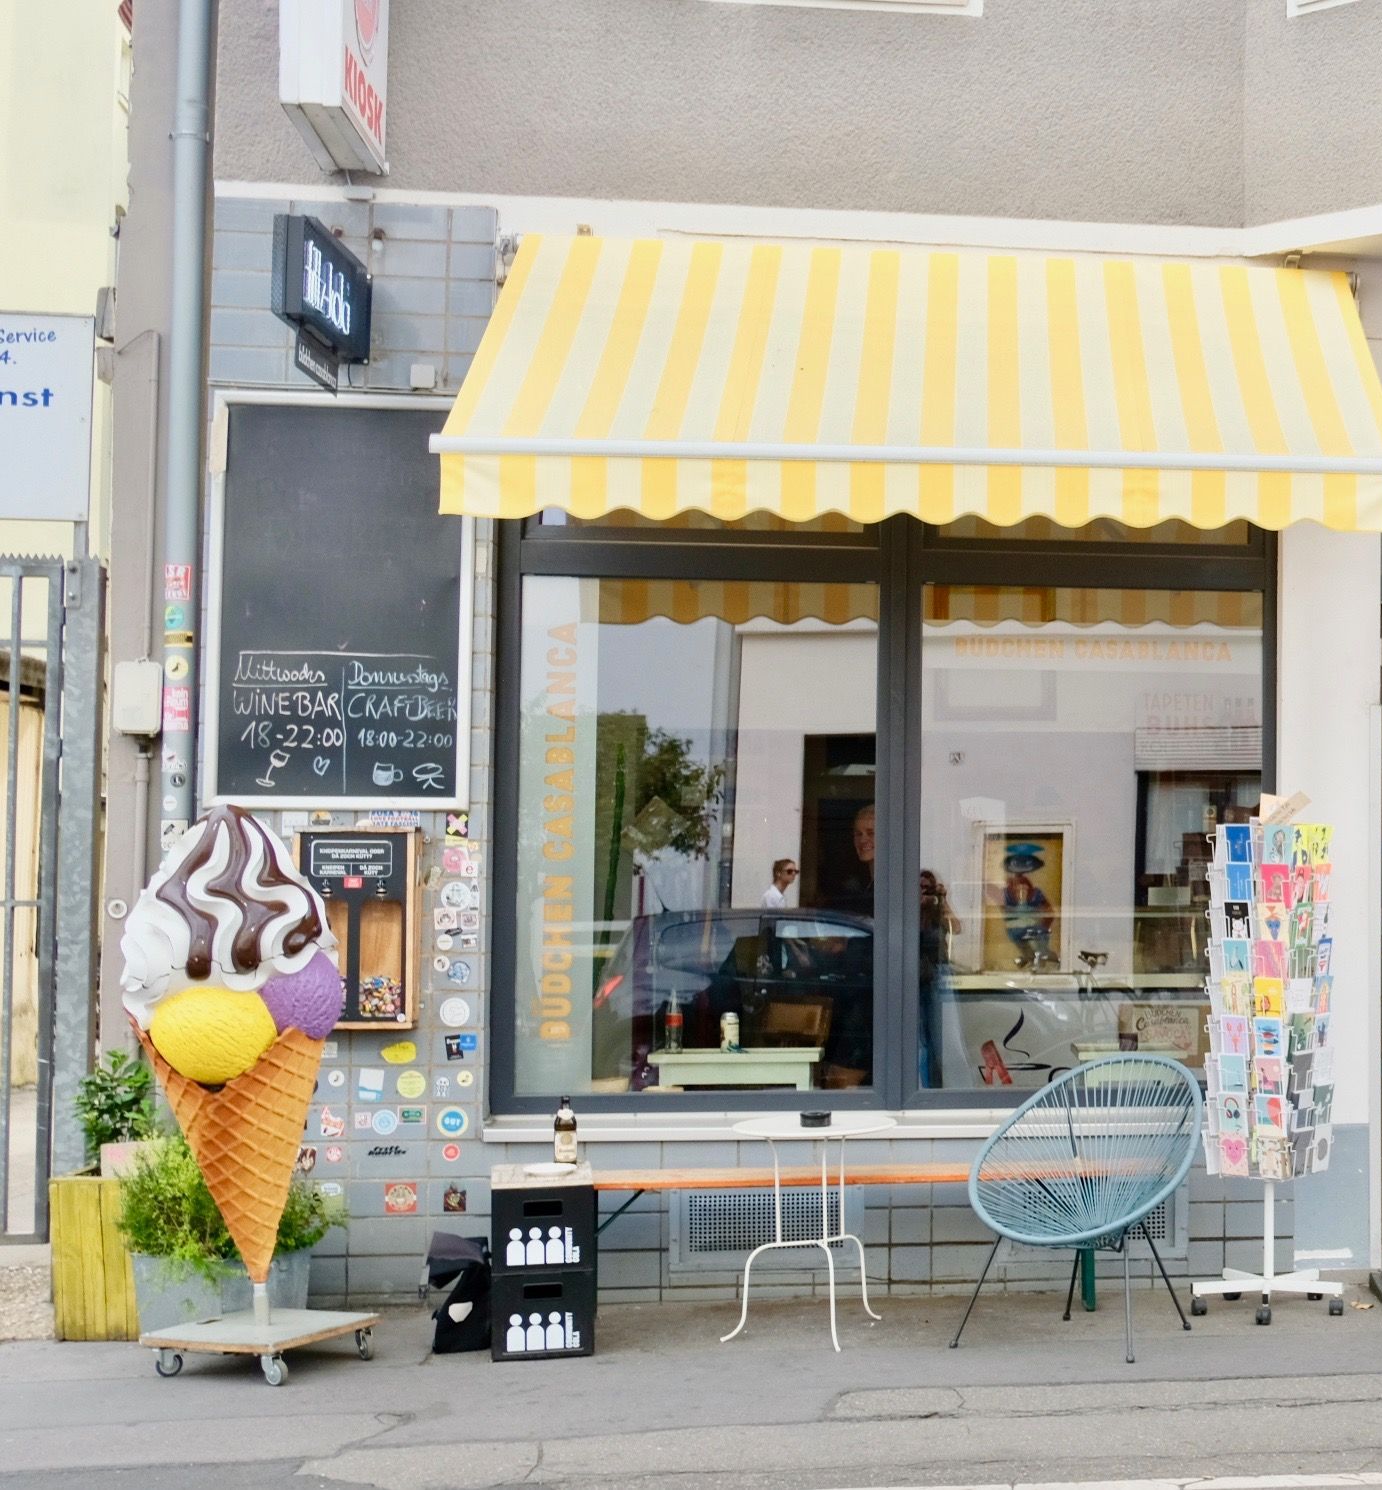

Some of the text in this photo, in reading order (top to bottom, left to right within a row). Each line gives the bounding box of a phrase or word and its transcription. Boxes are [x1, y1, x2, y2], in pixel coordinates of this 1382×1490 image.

[344, 44, 383, 146] KIOSK
[1074, 639, 1232, 662] CASABLANCA
[542, 621, 578, 862] CASABLANCA
